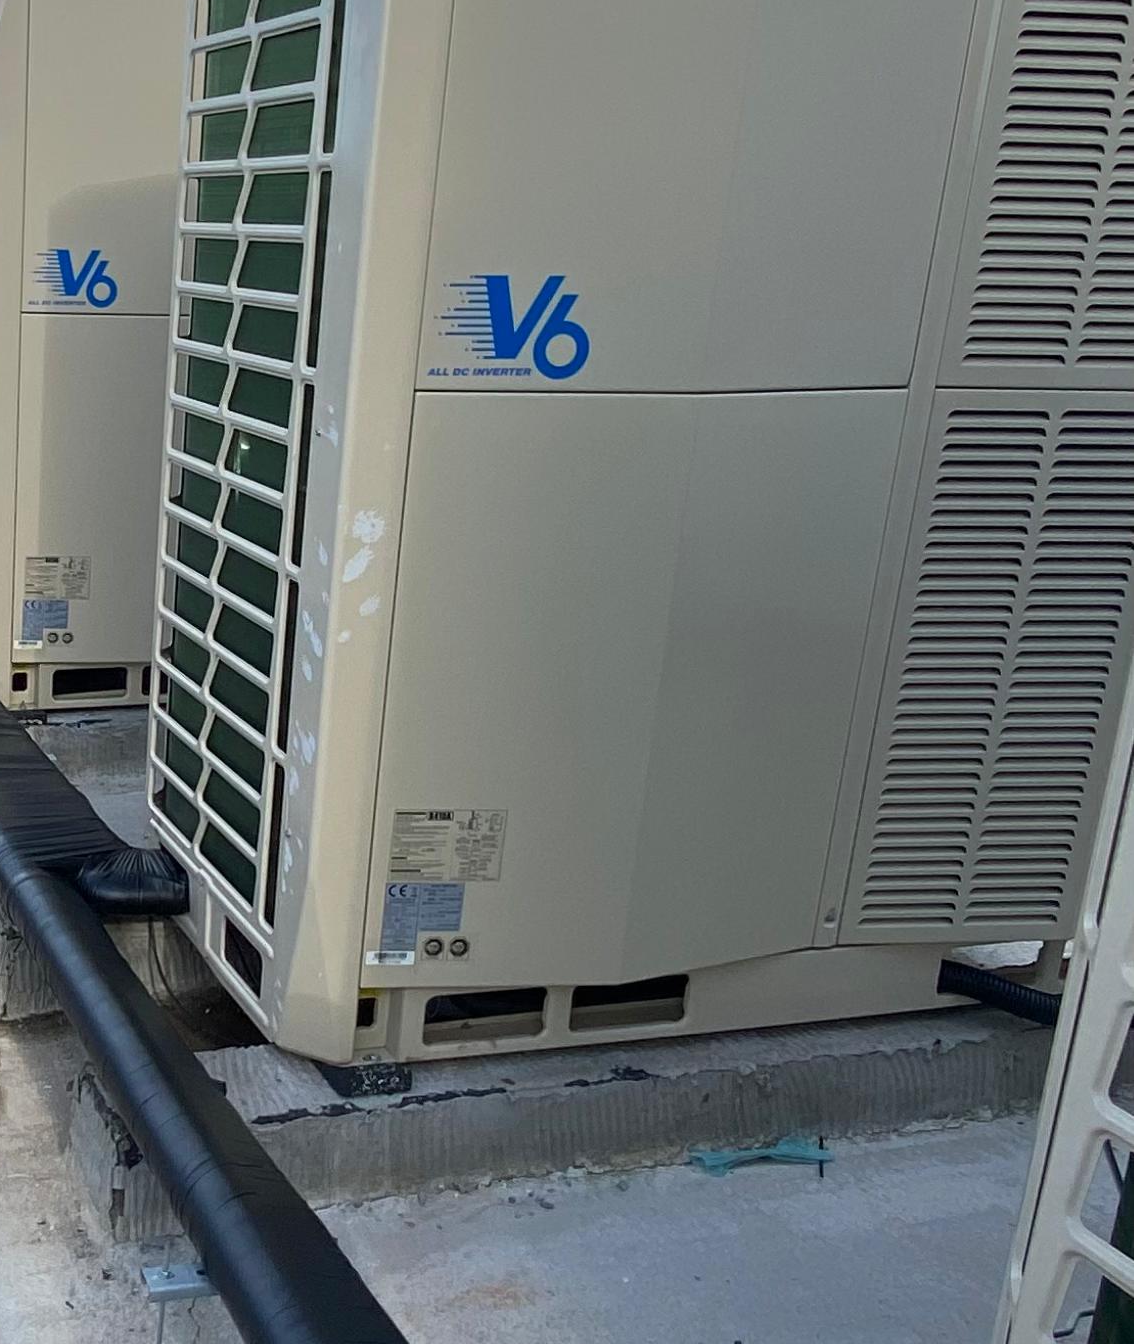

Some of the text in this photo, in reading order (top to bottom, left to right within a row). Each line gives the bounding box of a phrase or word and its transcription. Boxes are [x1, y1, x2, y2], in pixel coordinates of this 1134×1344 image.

[53, 248, 118, 308] V6
[478, 275, 590, 380] V6
[427, 367, 532, 376] ALL DC INVERTER
